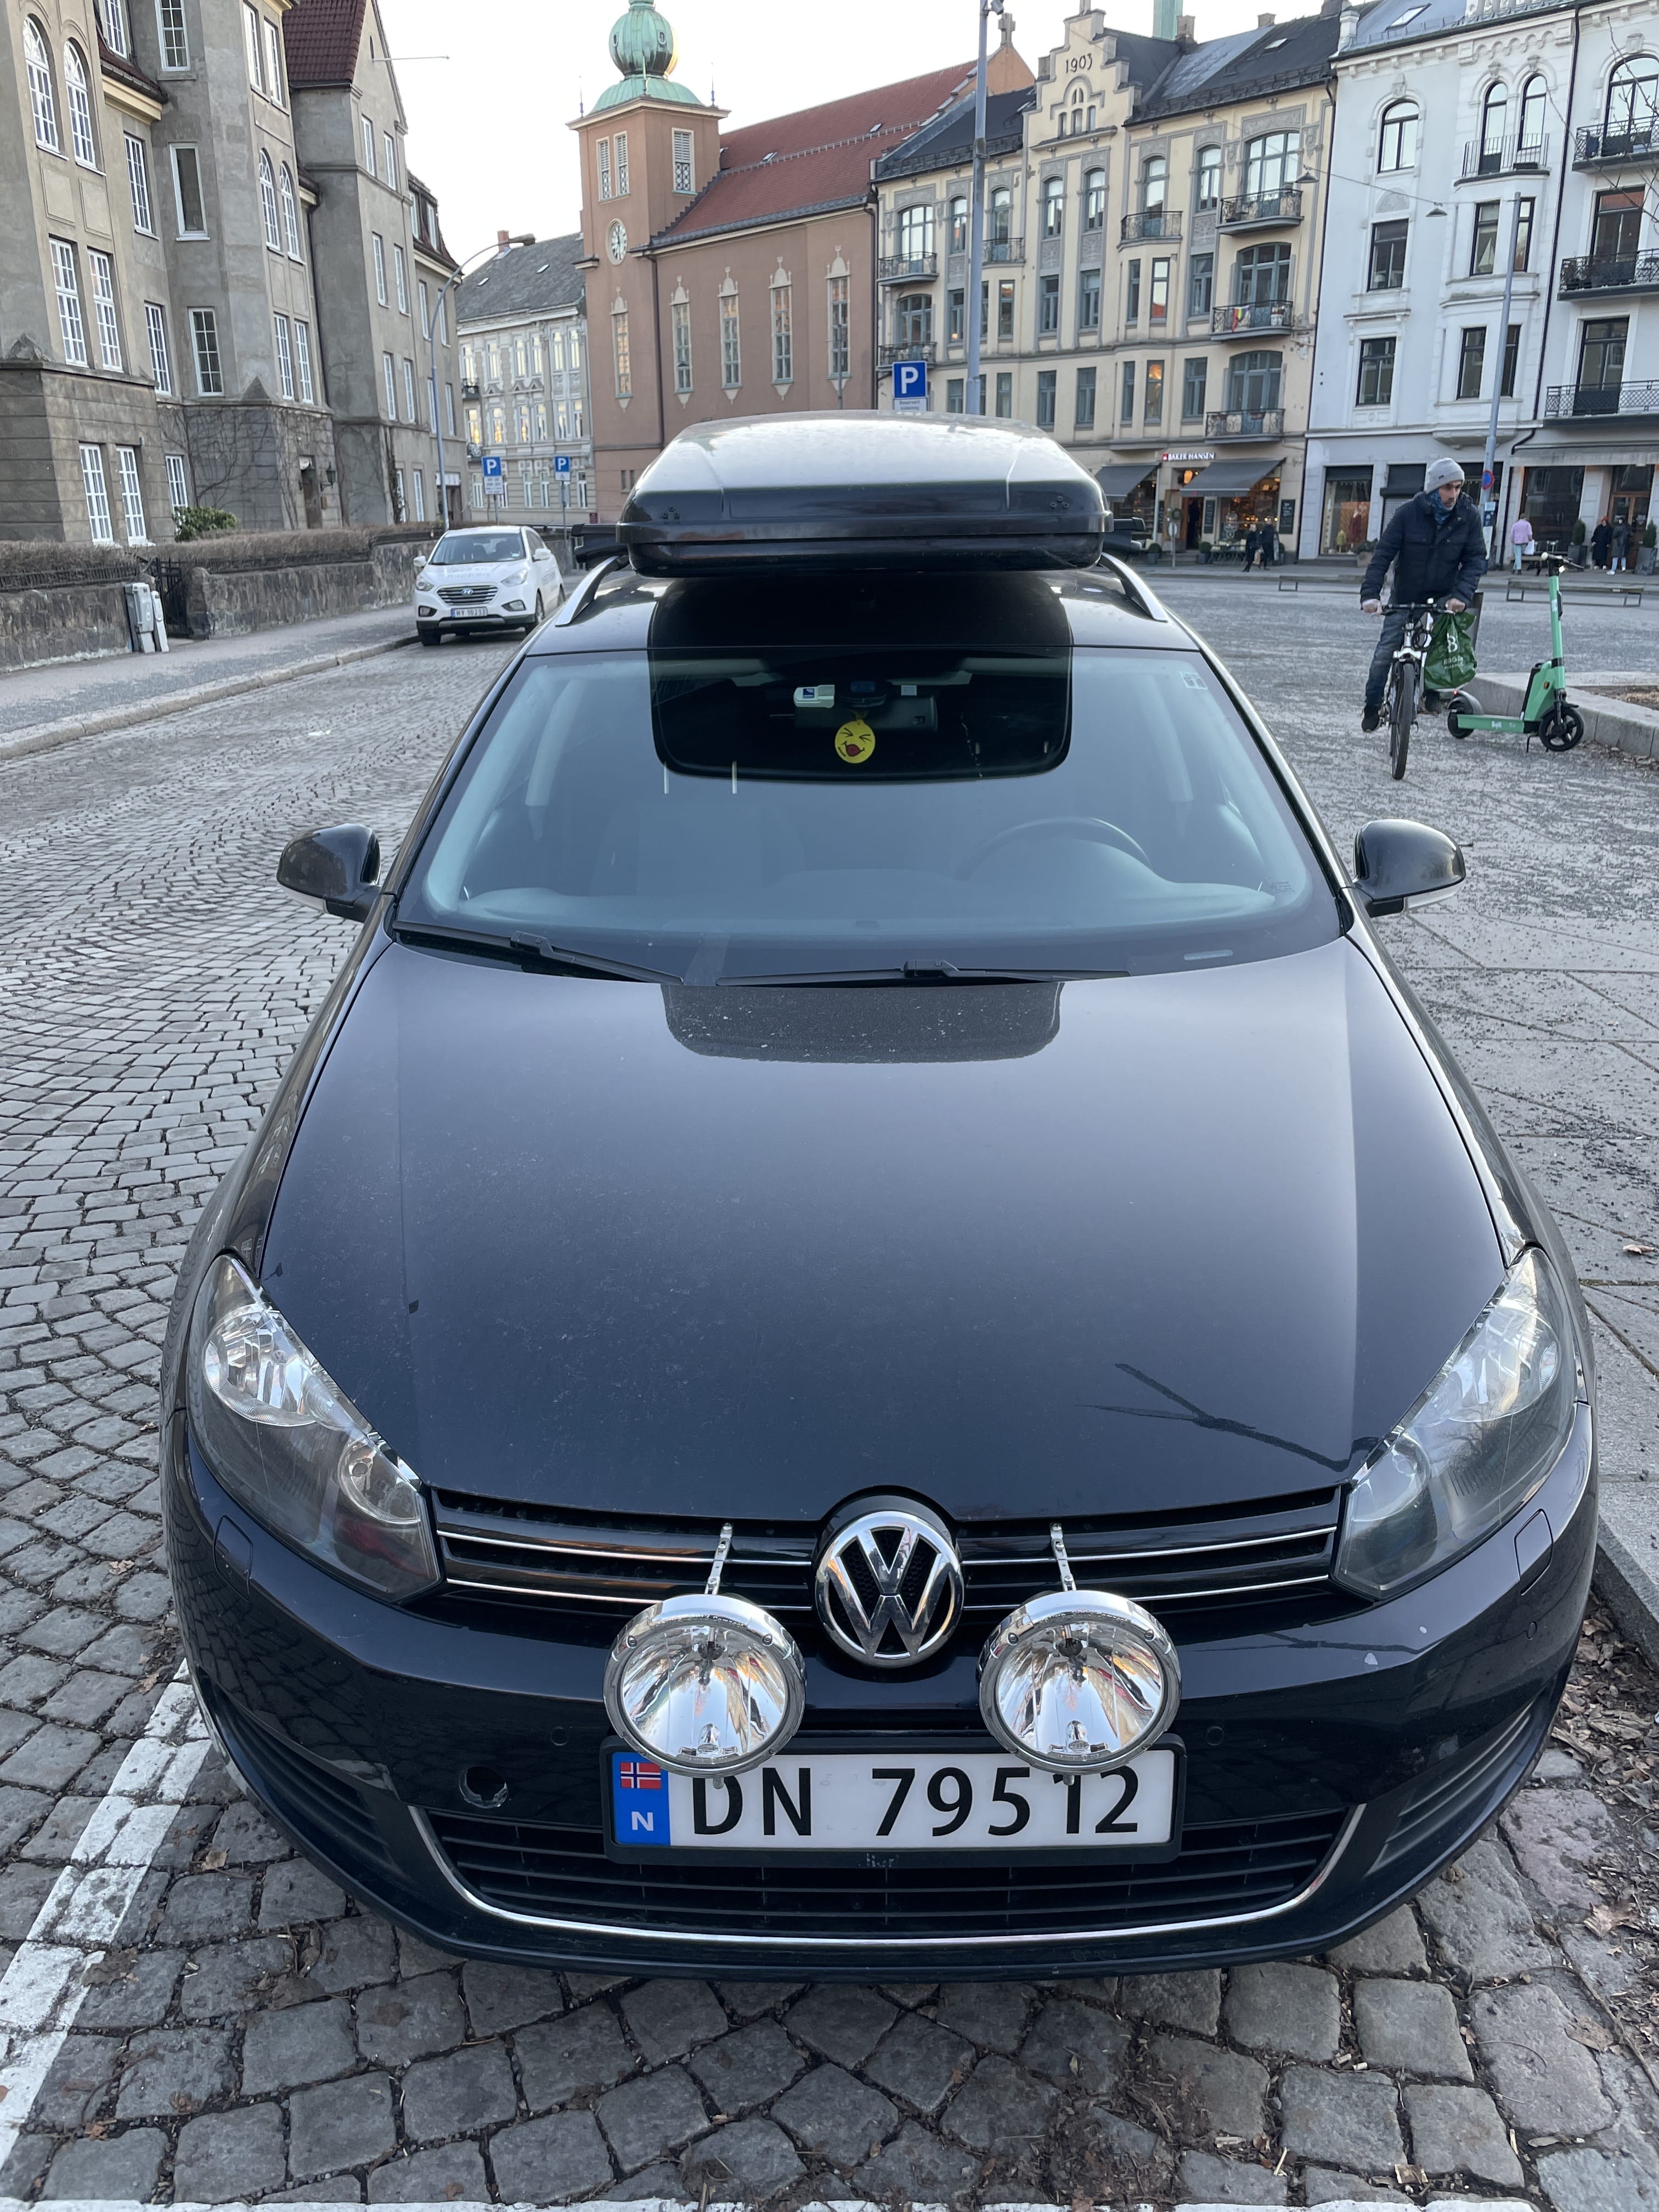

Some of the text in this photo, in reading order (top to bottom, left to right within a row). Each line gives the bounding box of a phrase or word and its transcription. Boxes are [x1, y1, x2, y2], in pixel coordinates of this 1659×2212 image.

[1066, 53, 1092, 74] 1903
[901, 366, 919, 394] P
[487, 459, 497, 475] P
[557, 458, 567, 470] P
[823, 1515, 957, 1660] VW
[692, 1766, 1139, 1837] DN 79512
[631, 1812, 654, 1831] N
